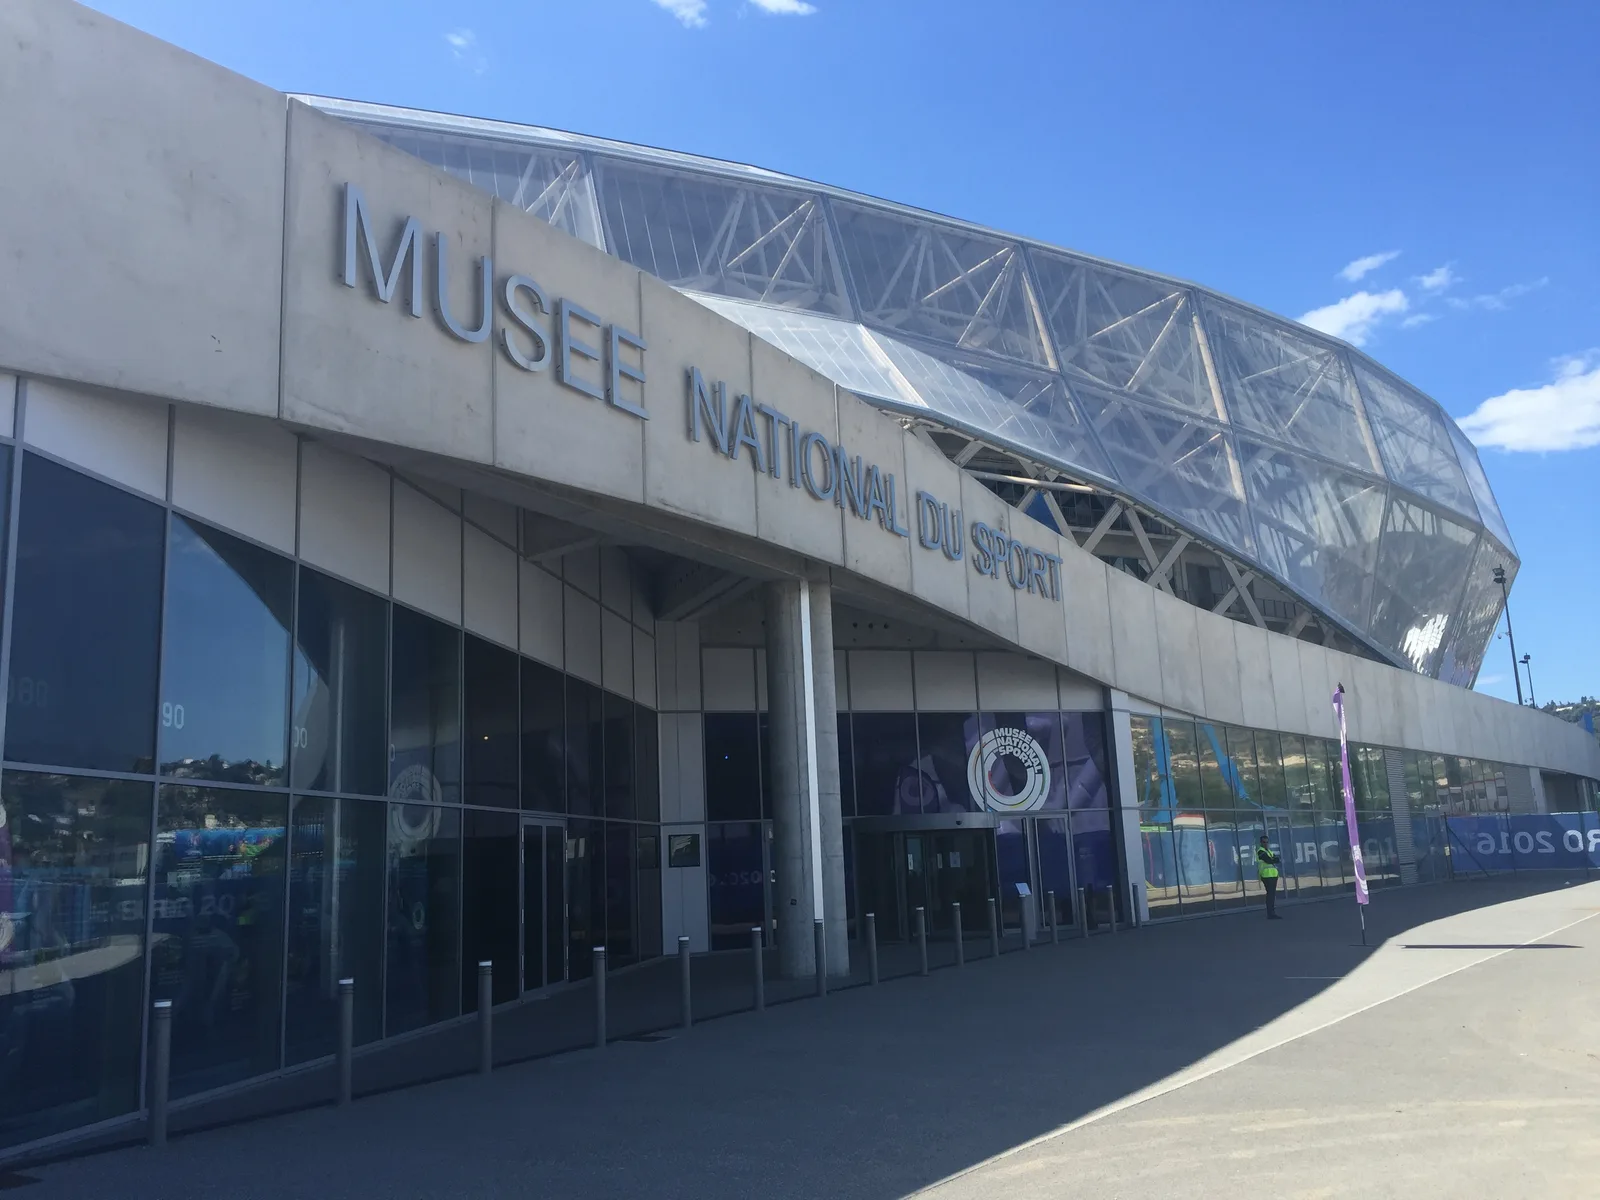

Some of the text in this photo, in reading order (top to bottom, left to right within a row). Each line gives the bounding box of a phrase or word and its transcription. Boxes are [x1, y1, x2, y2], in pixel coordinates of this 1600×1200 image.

[342, 181, 1063, 602] MUSEE NATIONAL DU SPORT
[162, 702, 185, 729] 90
[994, 727, 1033, 745] MUSÉE
[996, 736, 1043, 774] NATIONAL
[999, 746, 1033, 769] SPORT
